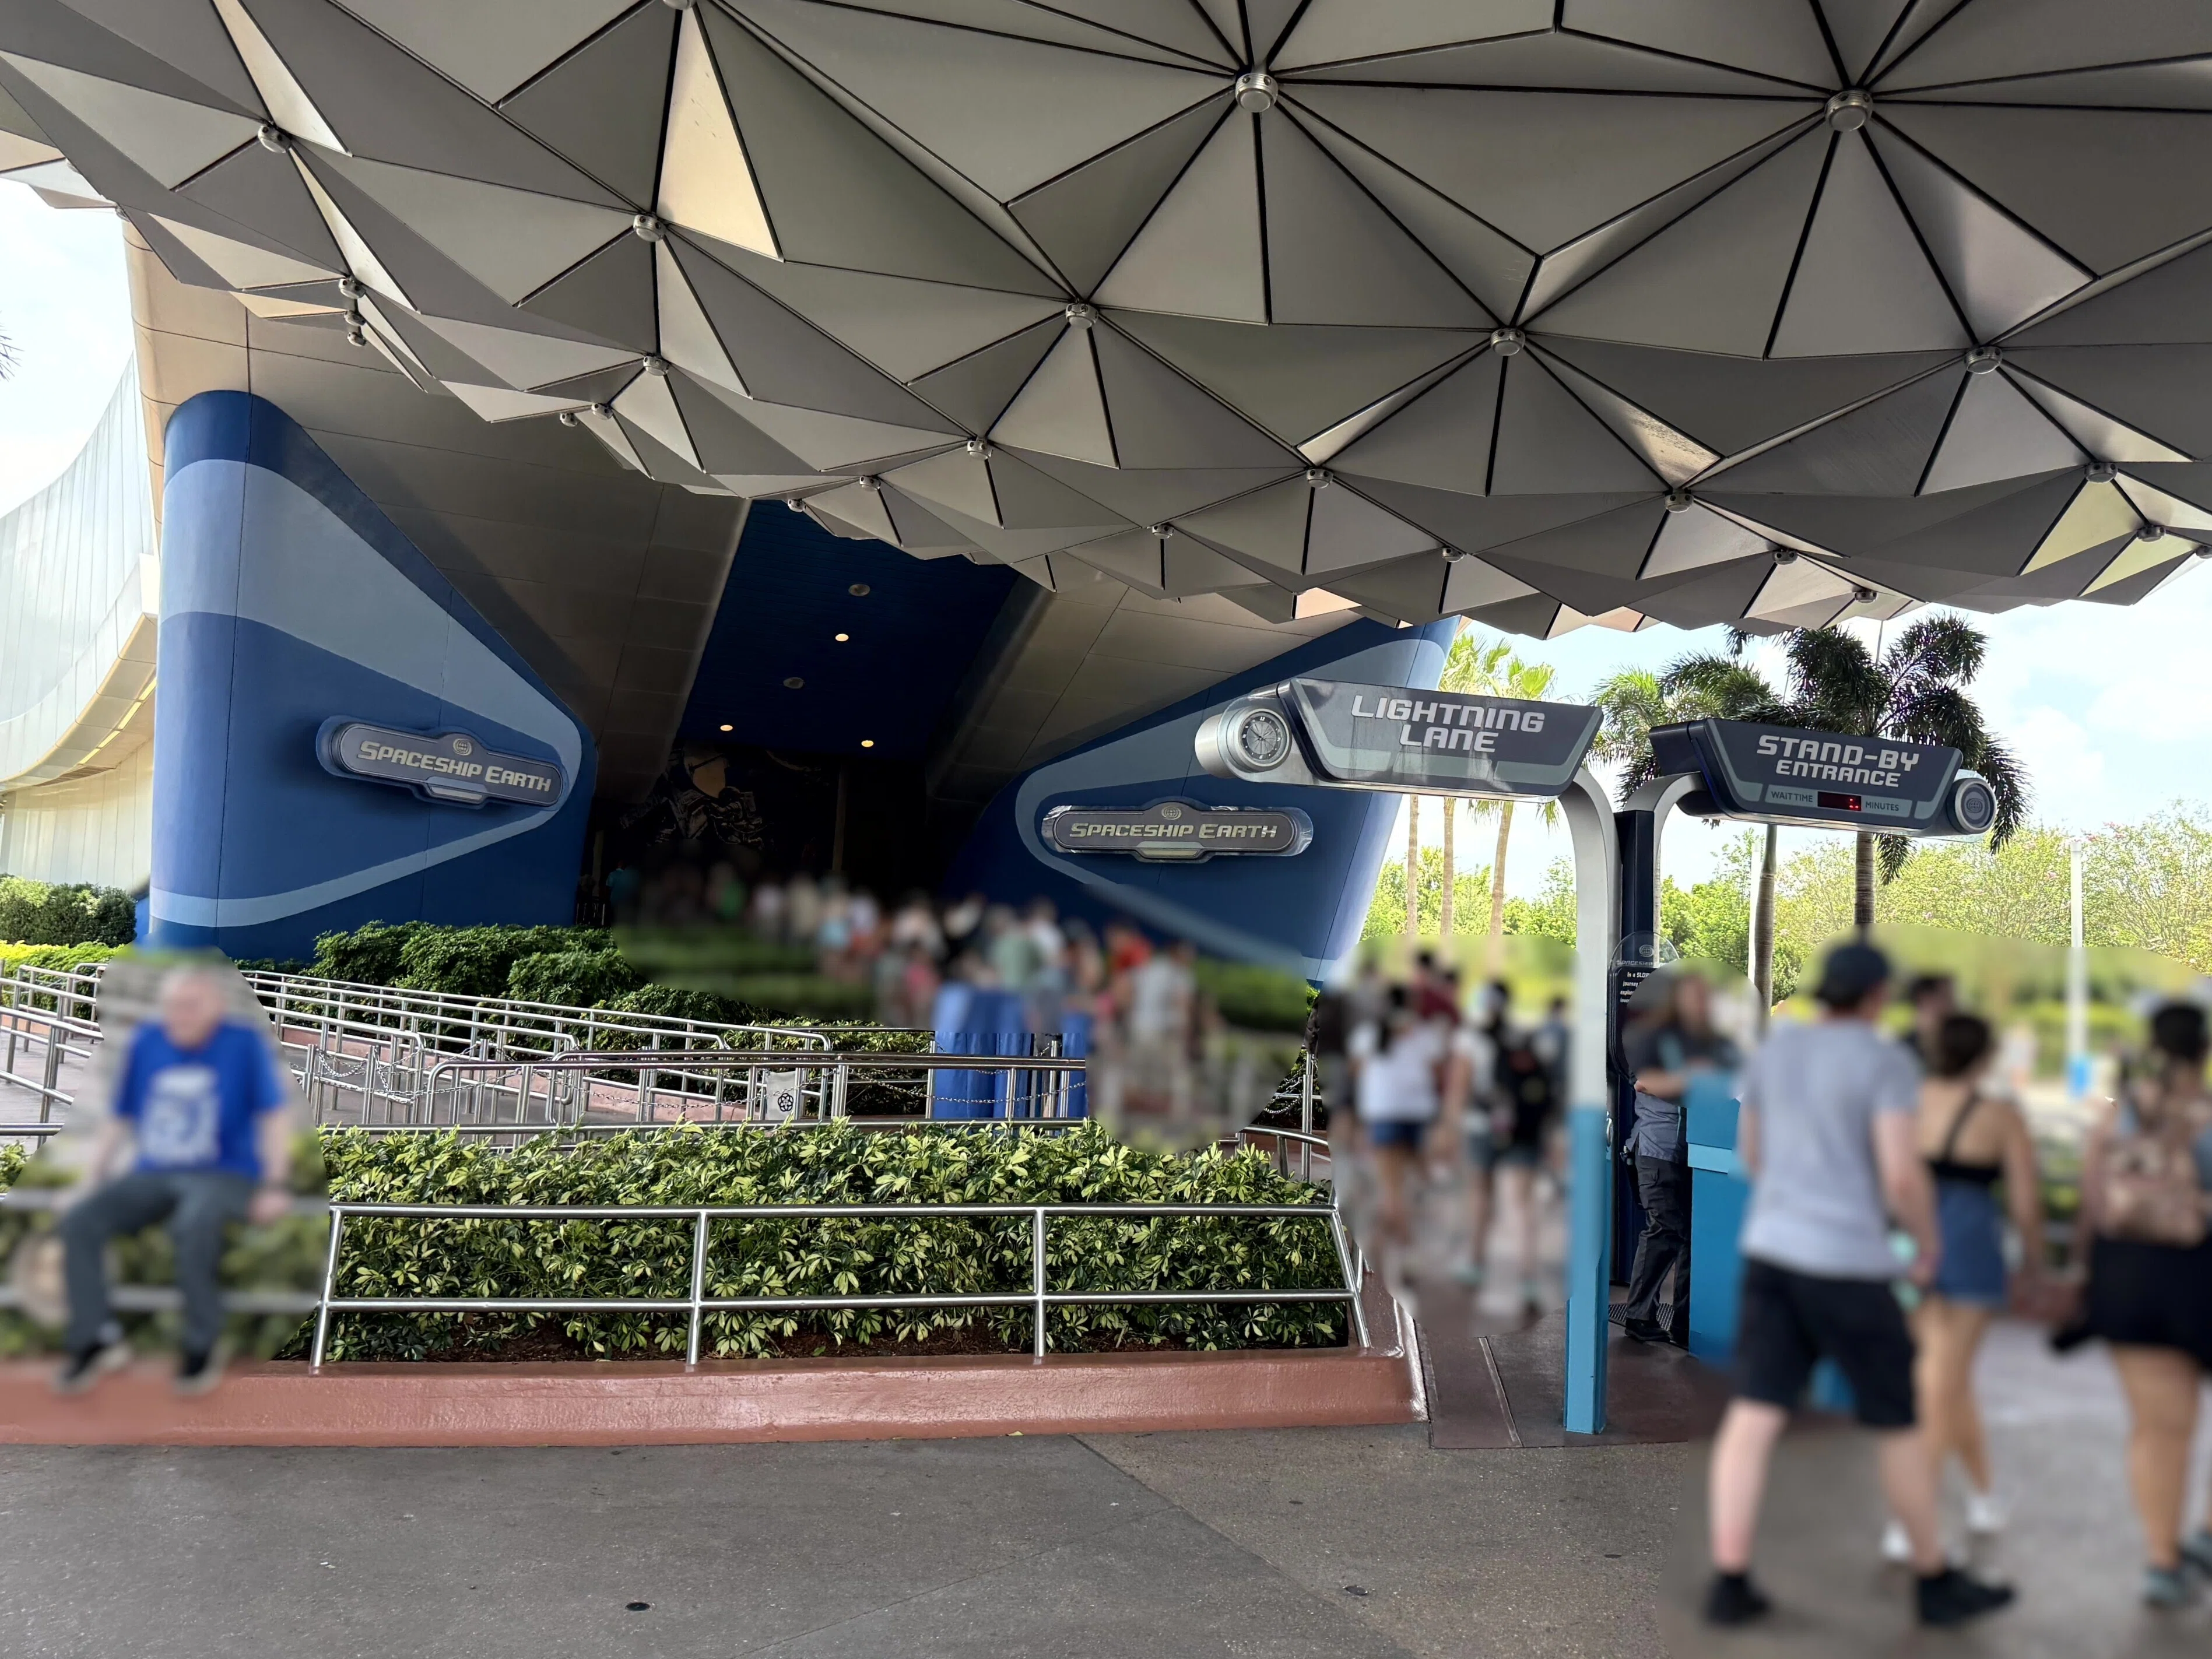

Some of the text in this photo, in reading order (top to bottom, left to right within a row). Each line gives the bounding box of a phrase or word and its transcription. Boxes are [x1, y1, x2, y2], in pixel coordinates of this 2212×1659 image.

[1351, 695, 1545, 733] LIGHTNING
[1399, 724, 1499, 753] LANE
[1757, 734, 1919, 771] STAND-BY
[357, 740, 552, 792] SPACESHIP EARTH
[1775, 760, 1901, 787] ENTRANCE
[1866, 801, 1899, 811] MINUTES
[1069, 823, 1278, 839] SPACESHIP EARTH
